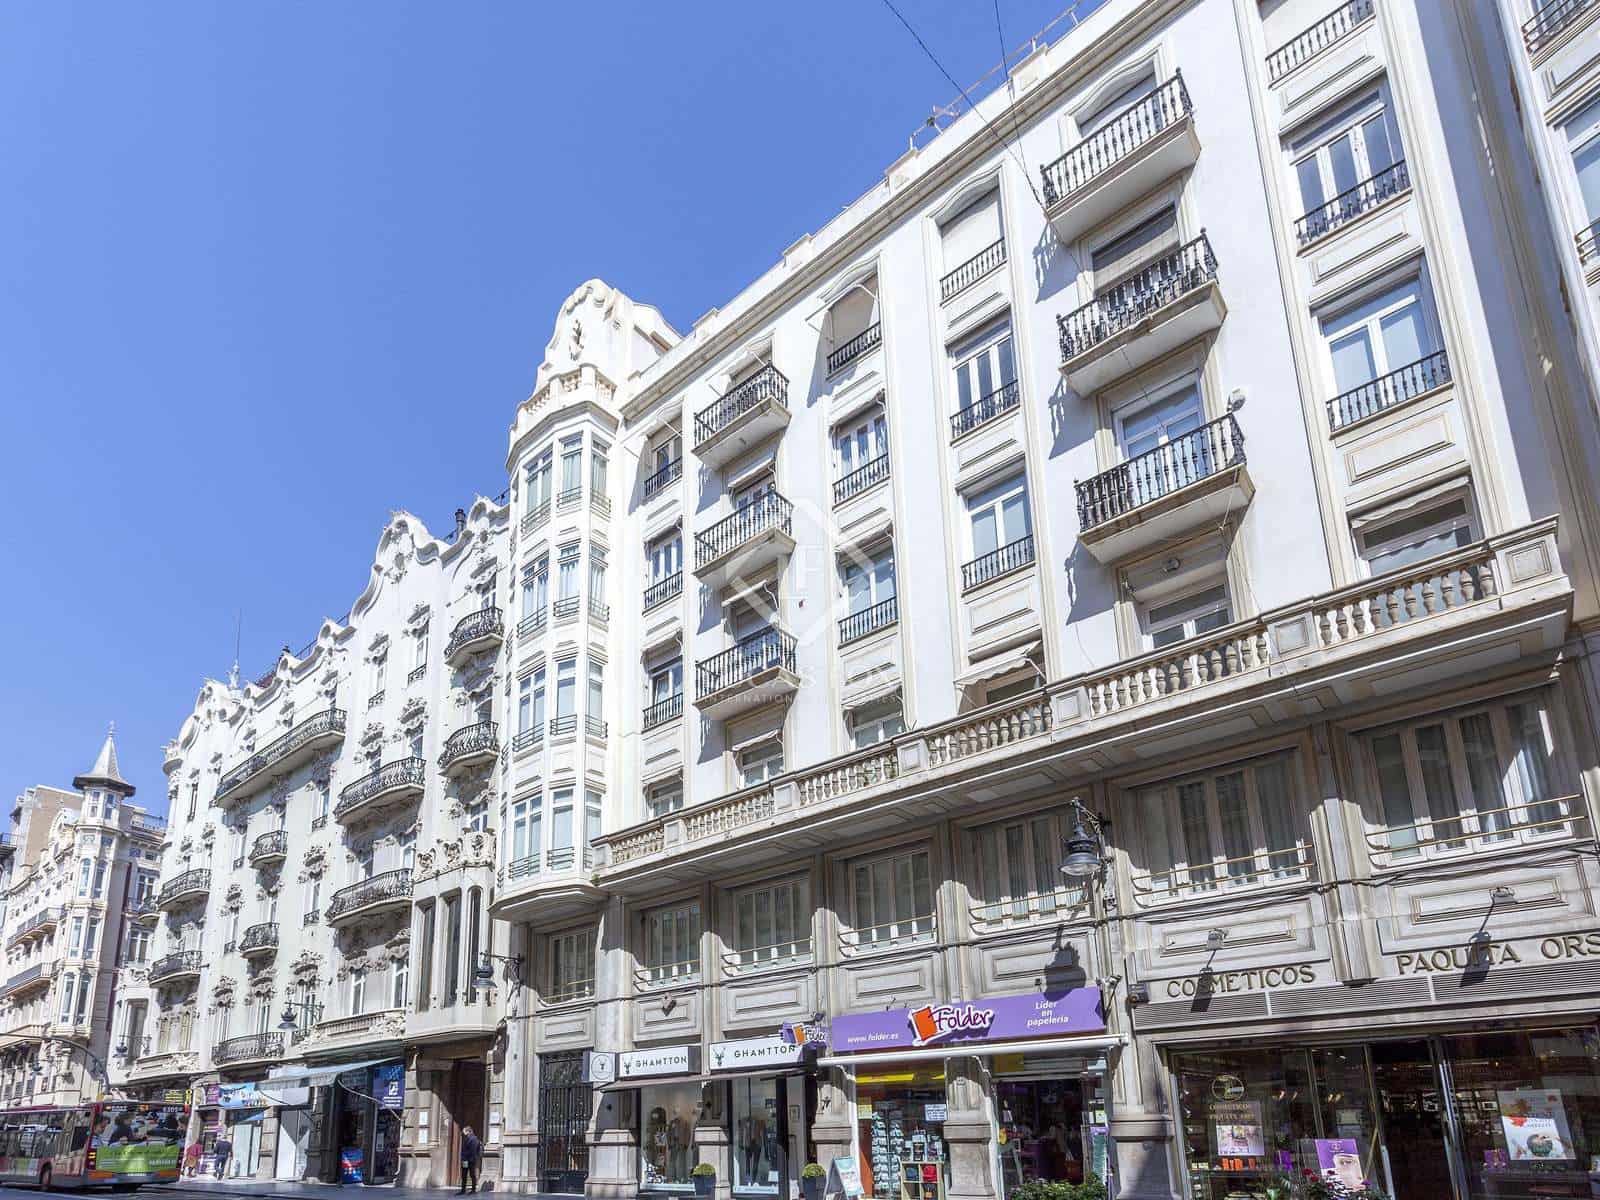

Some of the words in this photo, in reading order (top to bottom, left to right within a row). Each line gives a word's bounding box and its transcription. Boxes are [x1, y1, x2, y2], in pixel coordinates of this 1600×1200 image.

[1395, 943, 1522, 975] PAQUITA
[1541, 933, 1600, 959] ORS
[1167, 965, 1316, 998] COSMETICOS
[928, 1007, 991, 1031] Folder
[1041, 1009, 1053, 1017] en
